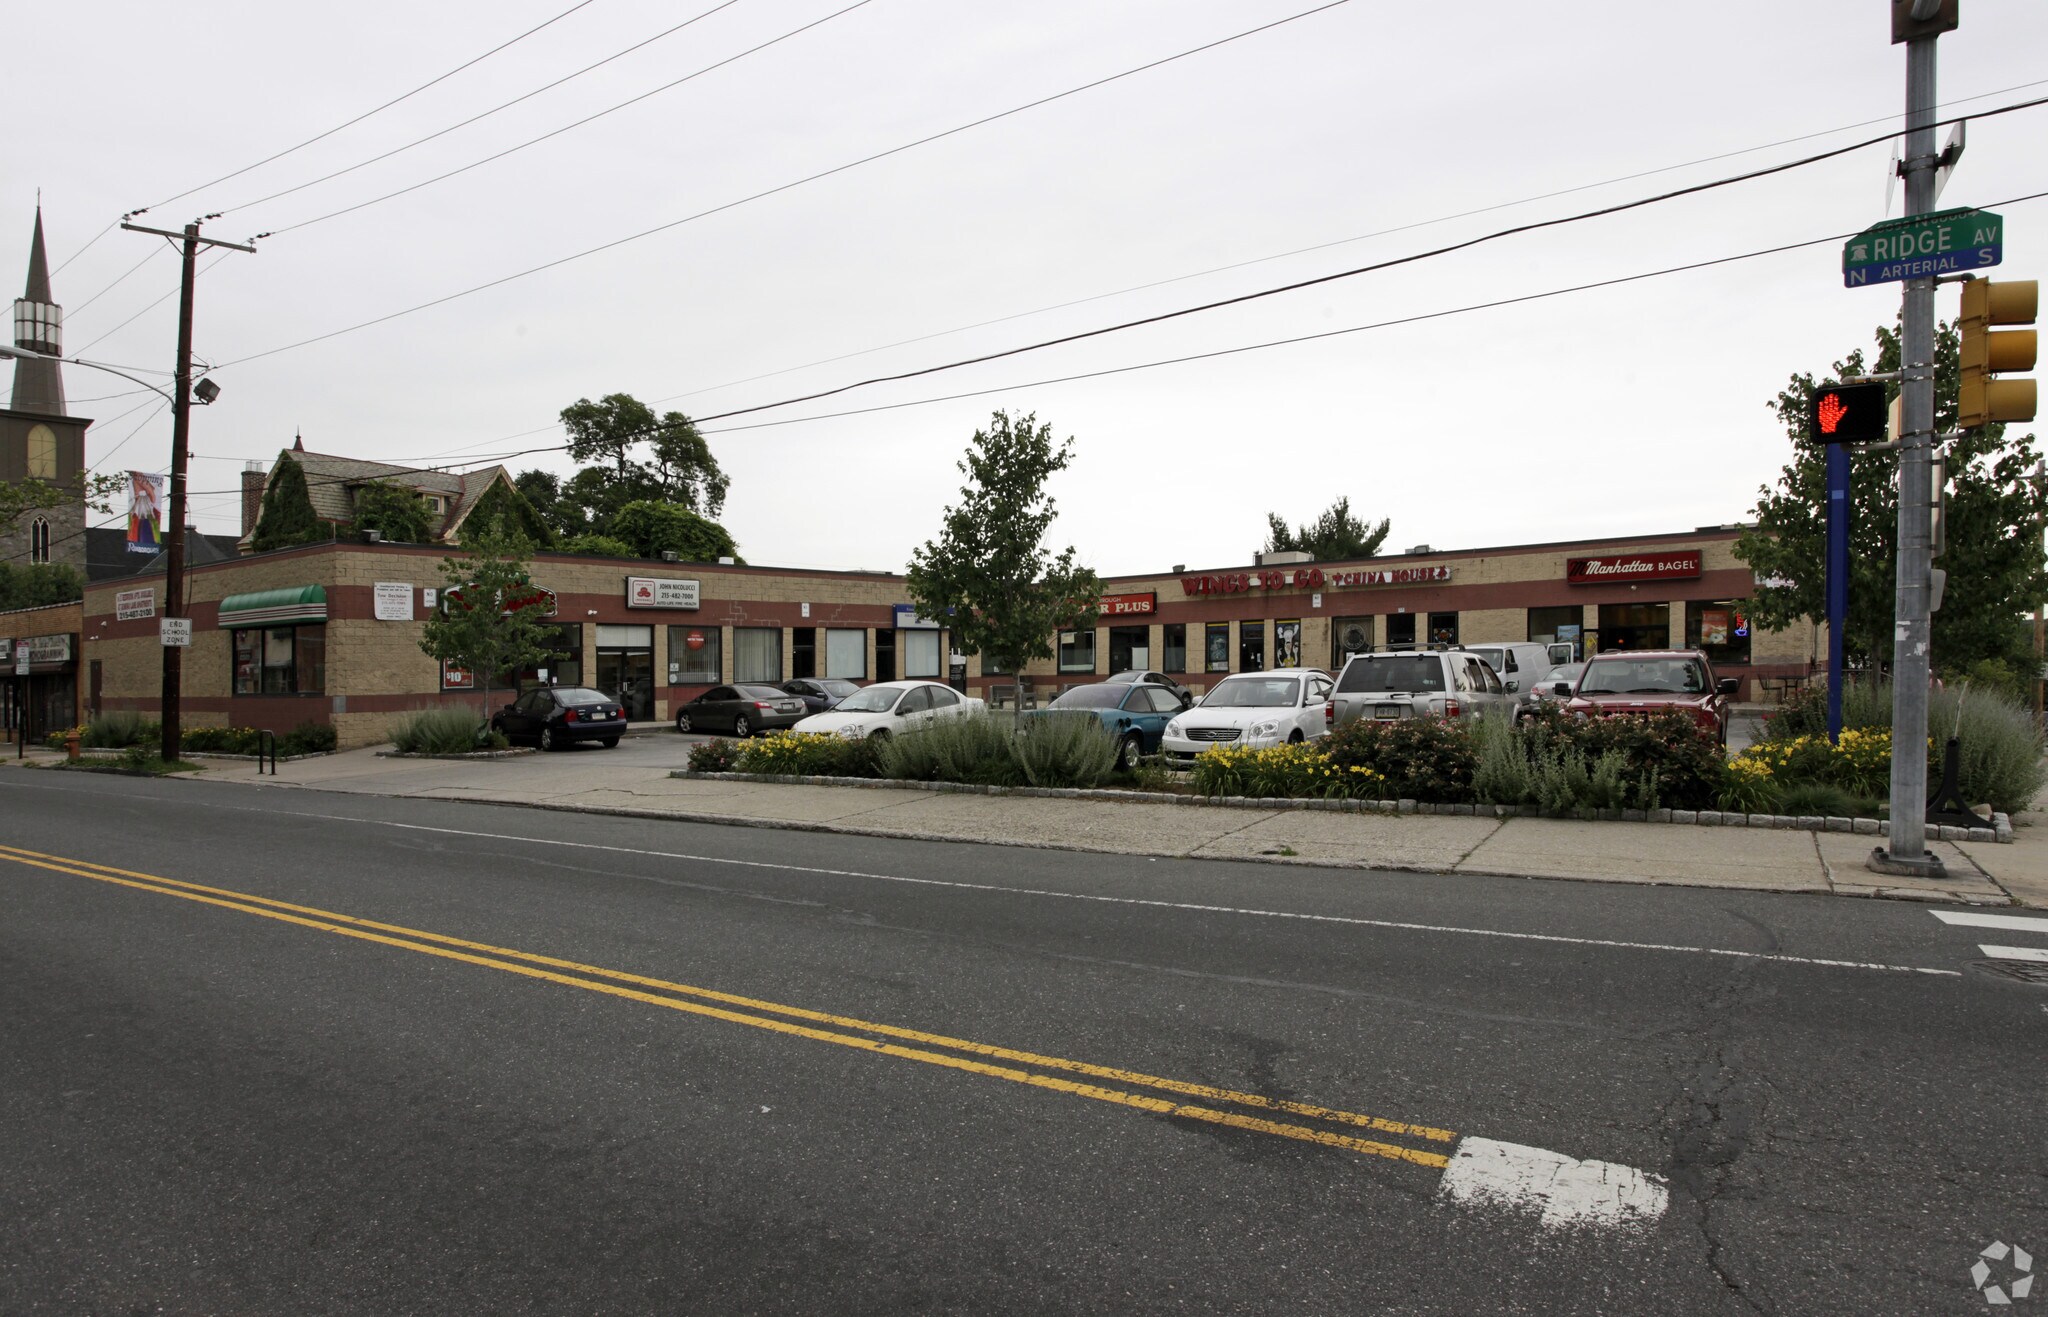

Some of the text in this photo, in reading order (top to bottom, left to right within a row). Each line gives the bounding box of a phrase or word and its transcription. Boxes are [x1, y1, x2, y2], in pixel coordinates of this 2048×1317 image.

[1874, 226, 1997, 261] RIDGE AV
[1850, 248, 1994, 286] N ARTERIAL S
[1586, 559, 1654, 575] Manhattan
[1658, 560, 1695, 571] BAGEL
[1180, 568, 1325, 597] WINGS TO GO
[1343, 567, 1436, 585] CHINA HOUSE
[661, 592, 694, 600] 215-482-7000
[1115, 601, 1150, 613] PLUS
[446, 672, 462, 683] $10
